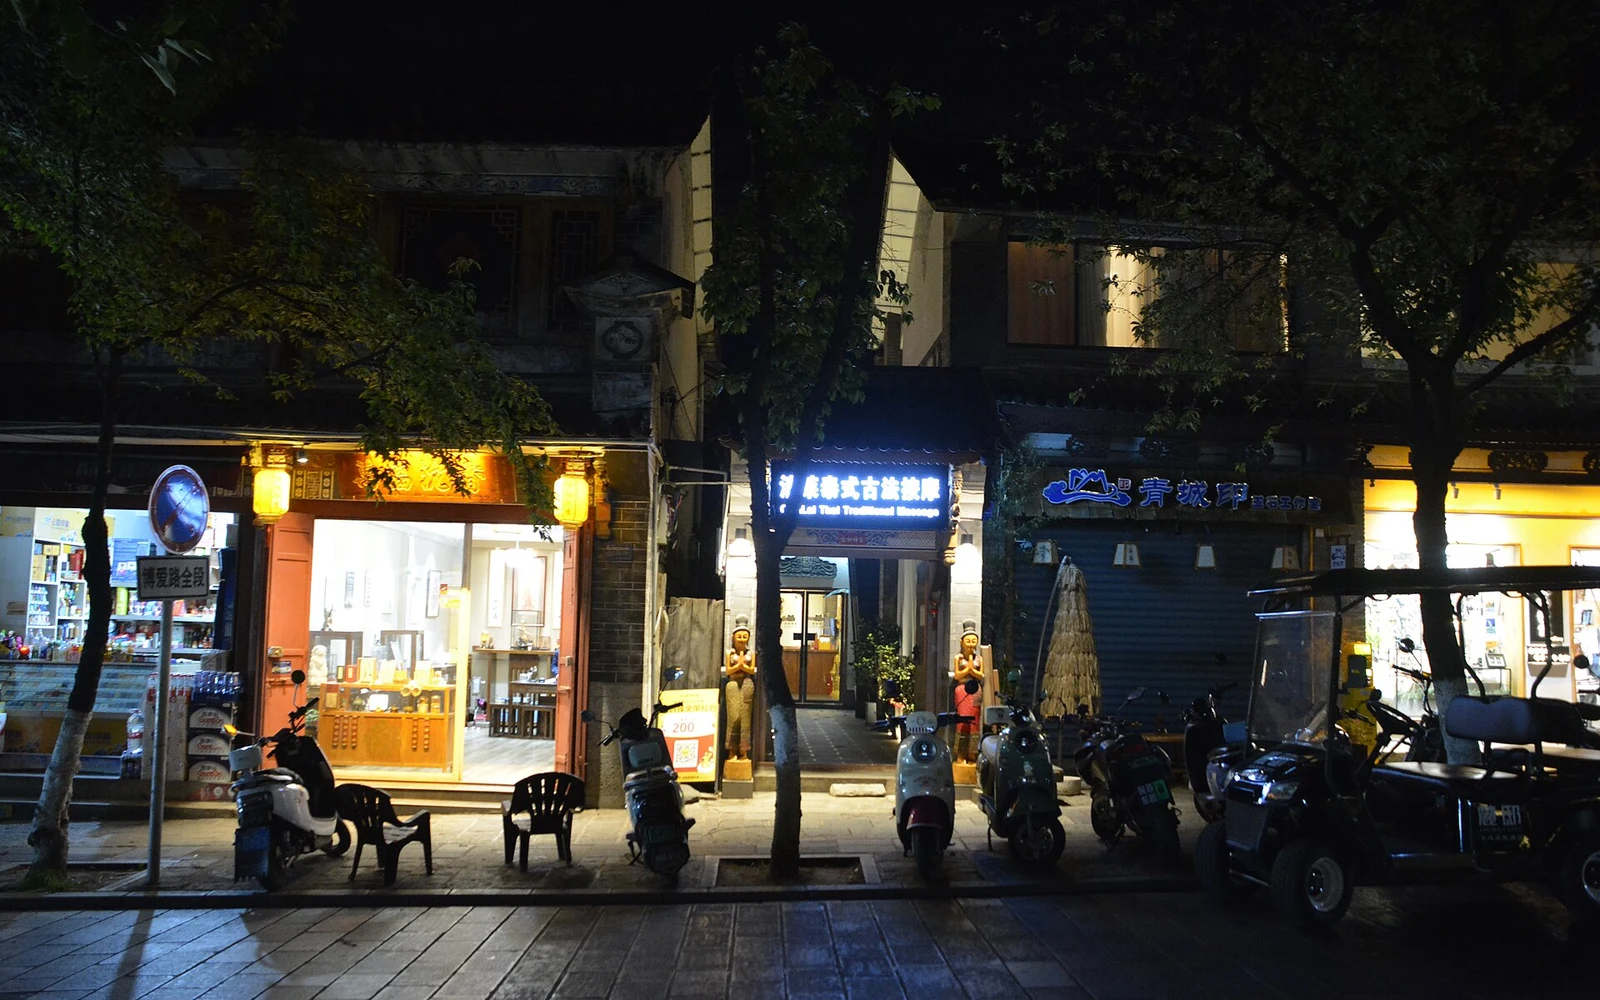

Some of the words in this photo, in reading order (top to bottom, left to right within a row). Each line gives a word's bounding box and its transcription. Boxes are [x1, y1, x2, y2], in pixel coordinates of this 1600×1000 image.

[1138, 477, 1249, 511] 青城印
[1251, 494, 1322, 510] 玉石工作室
[818, 505, 840, 515] Thai
[142, 567, 204, 588] 博爱路全段
[673, 722, 695, 733] 200
